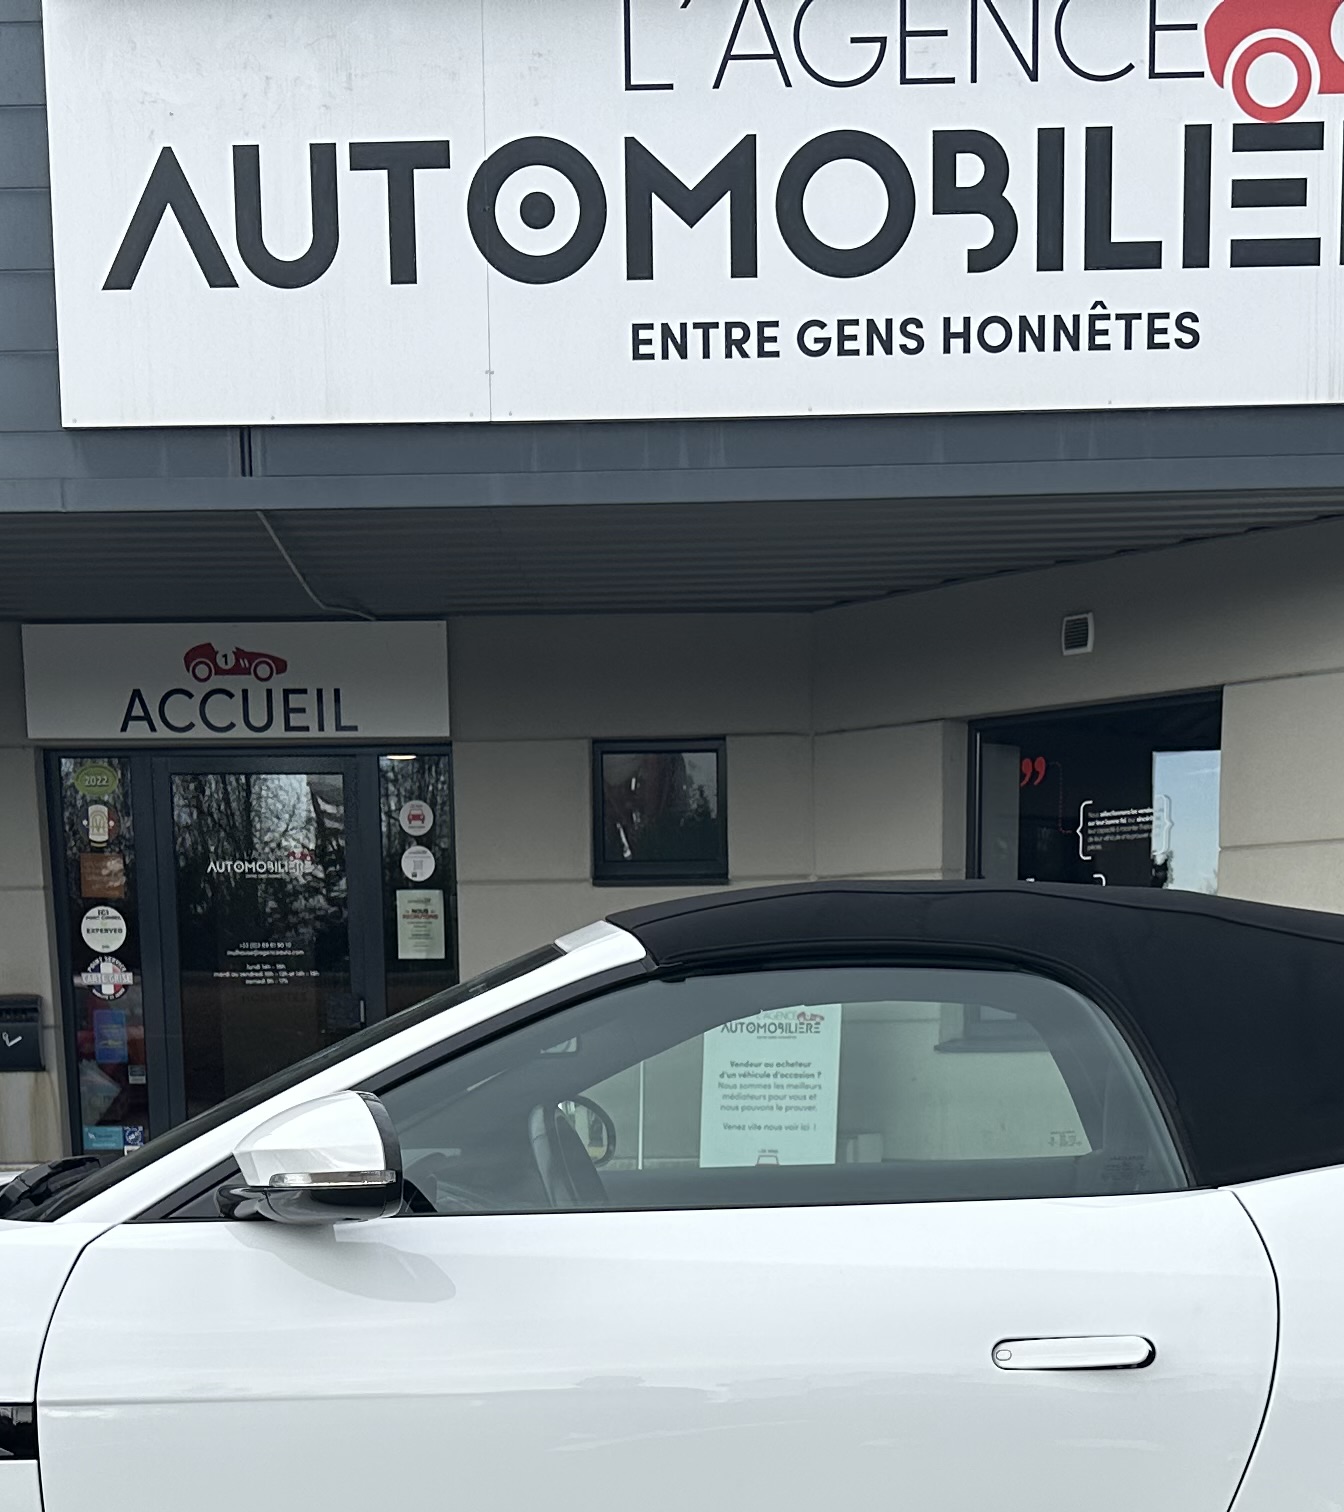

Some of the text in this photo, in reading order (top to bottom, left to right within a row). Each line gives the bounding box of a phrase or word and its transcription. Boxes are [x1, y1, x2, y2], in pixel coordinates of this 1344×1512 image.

[631, 300, 1201, 361] ENTRE GENS HONNÊTES
[119, 687, 359, 734] ACCUEIL
[84, 775, 108, 786] 2022
[729, 1060, 763, 1068] Vendeur
[775, 1060, 812, 1068] acheteur
[738, 1071, 771, 1079] véhicule
[772, 1071, 815, 1079] d'occasion
[785, 1081, 822, 1090] meilleurs
[767, 1093, 787, 1103] pour
